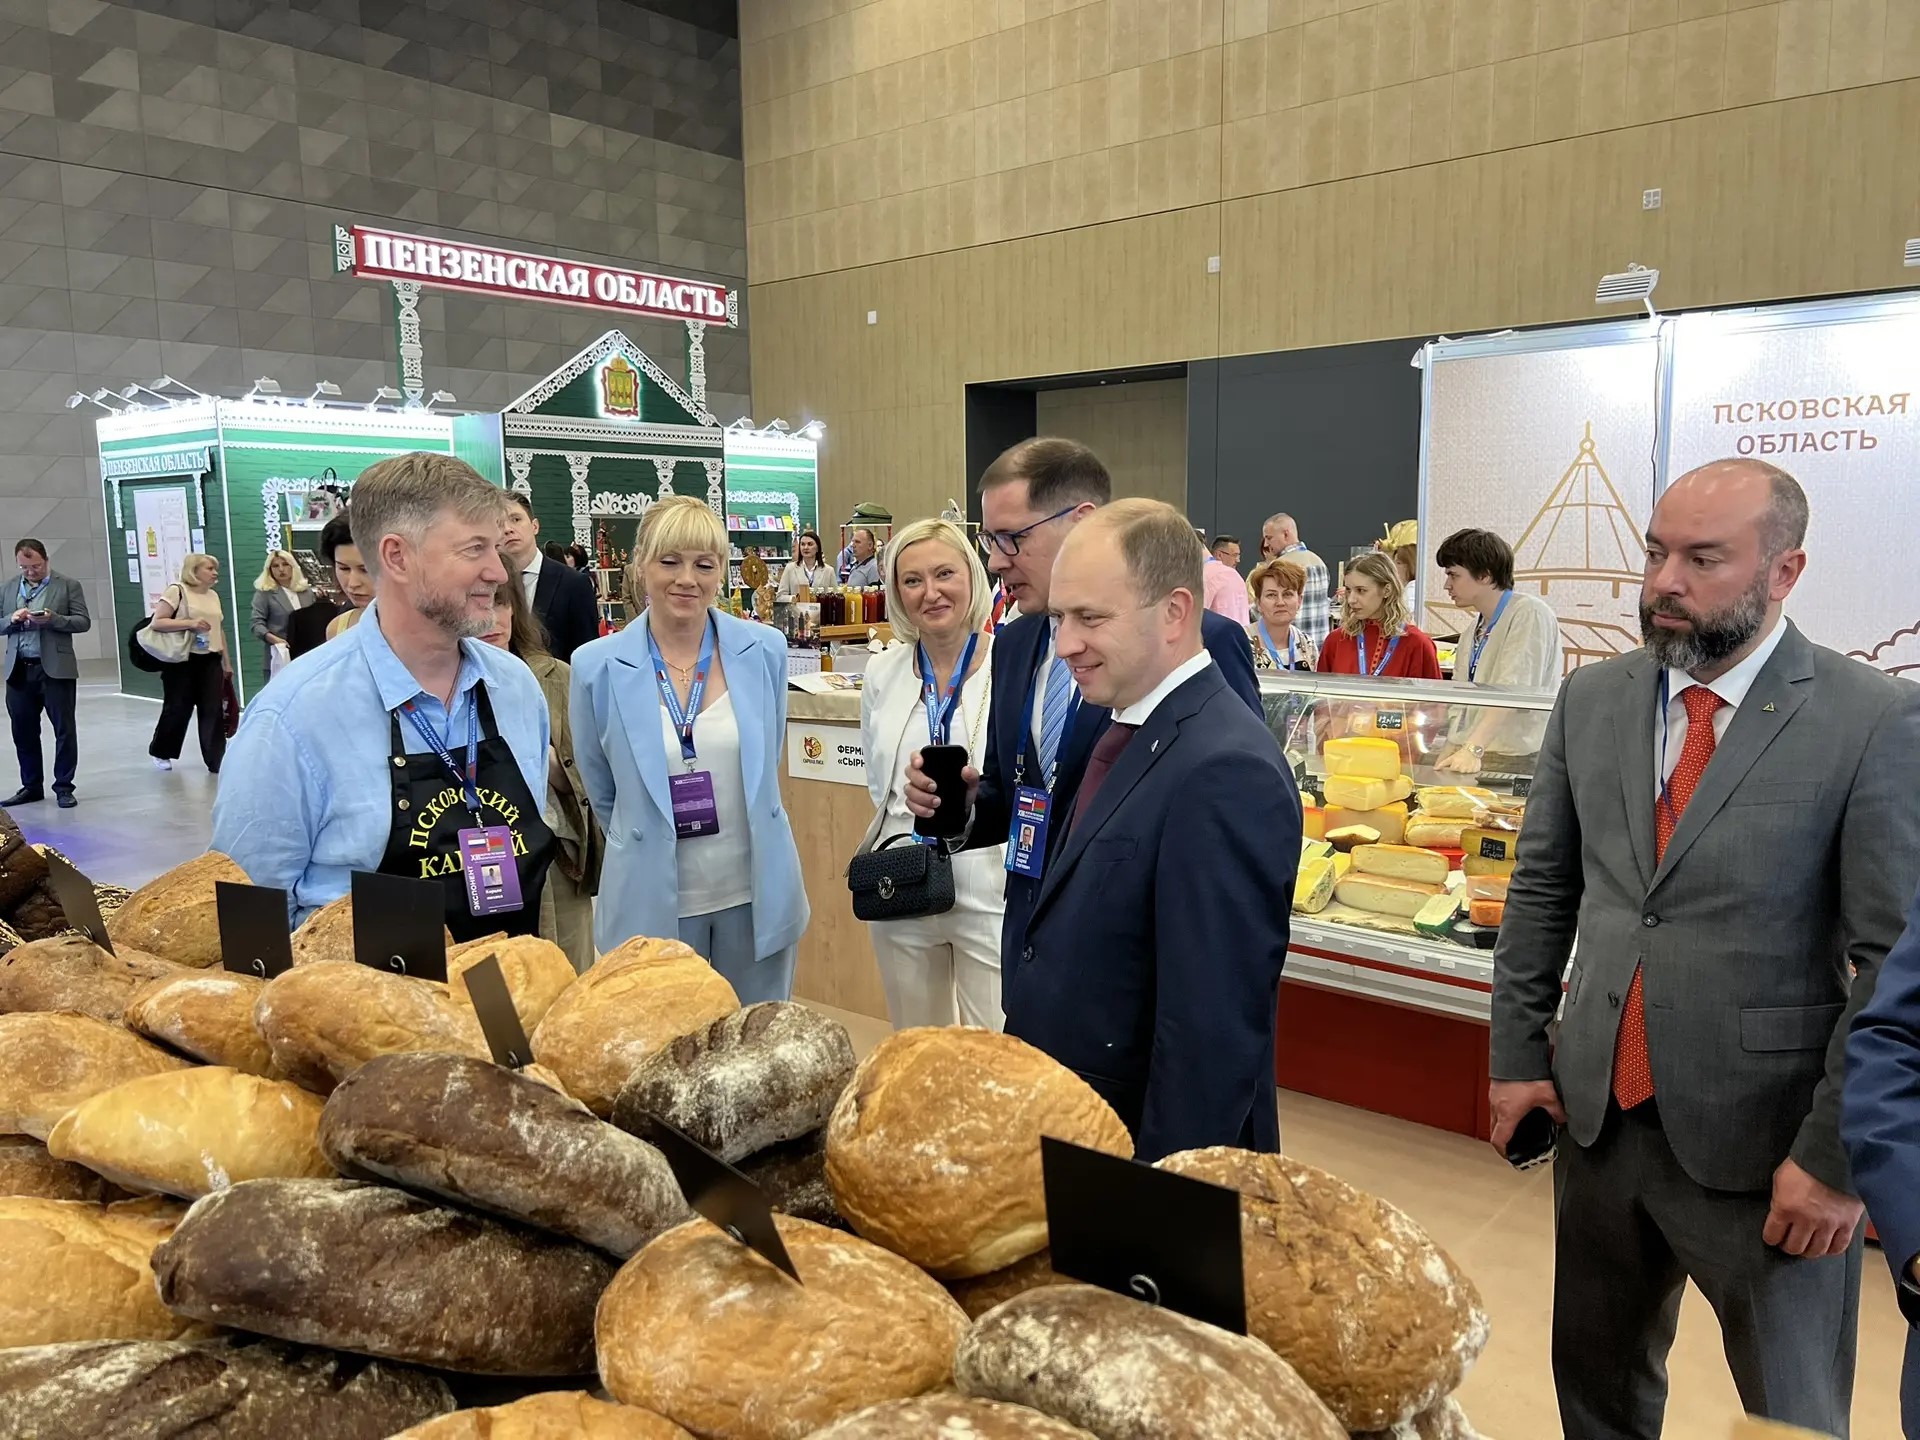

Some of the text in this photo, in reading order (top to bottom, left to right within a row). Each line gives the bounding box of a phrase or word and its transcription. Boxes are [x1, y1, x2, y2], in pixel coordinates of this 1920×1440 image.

[363, 234, 726, 316] ПЕНЗЕНСКАЯ ОБЛАСТЬ
[1713, 392, 1911, 424] ПСКОВСКАЯ
[1736, 429, 1878, 455] ОБЛАСТЬ
[107, 451, 204, 476] ПЕНЗЕНСКАЯ ОБЛАСТЬ
[440, 752, 456, 768] XIII
[837, 745, 864, 756] ФЕРМ
[467, 865, 481, 911] ЭКСПОНЕНТ
